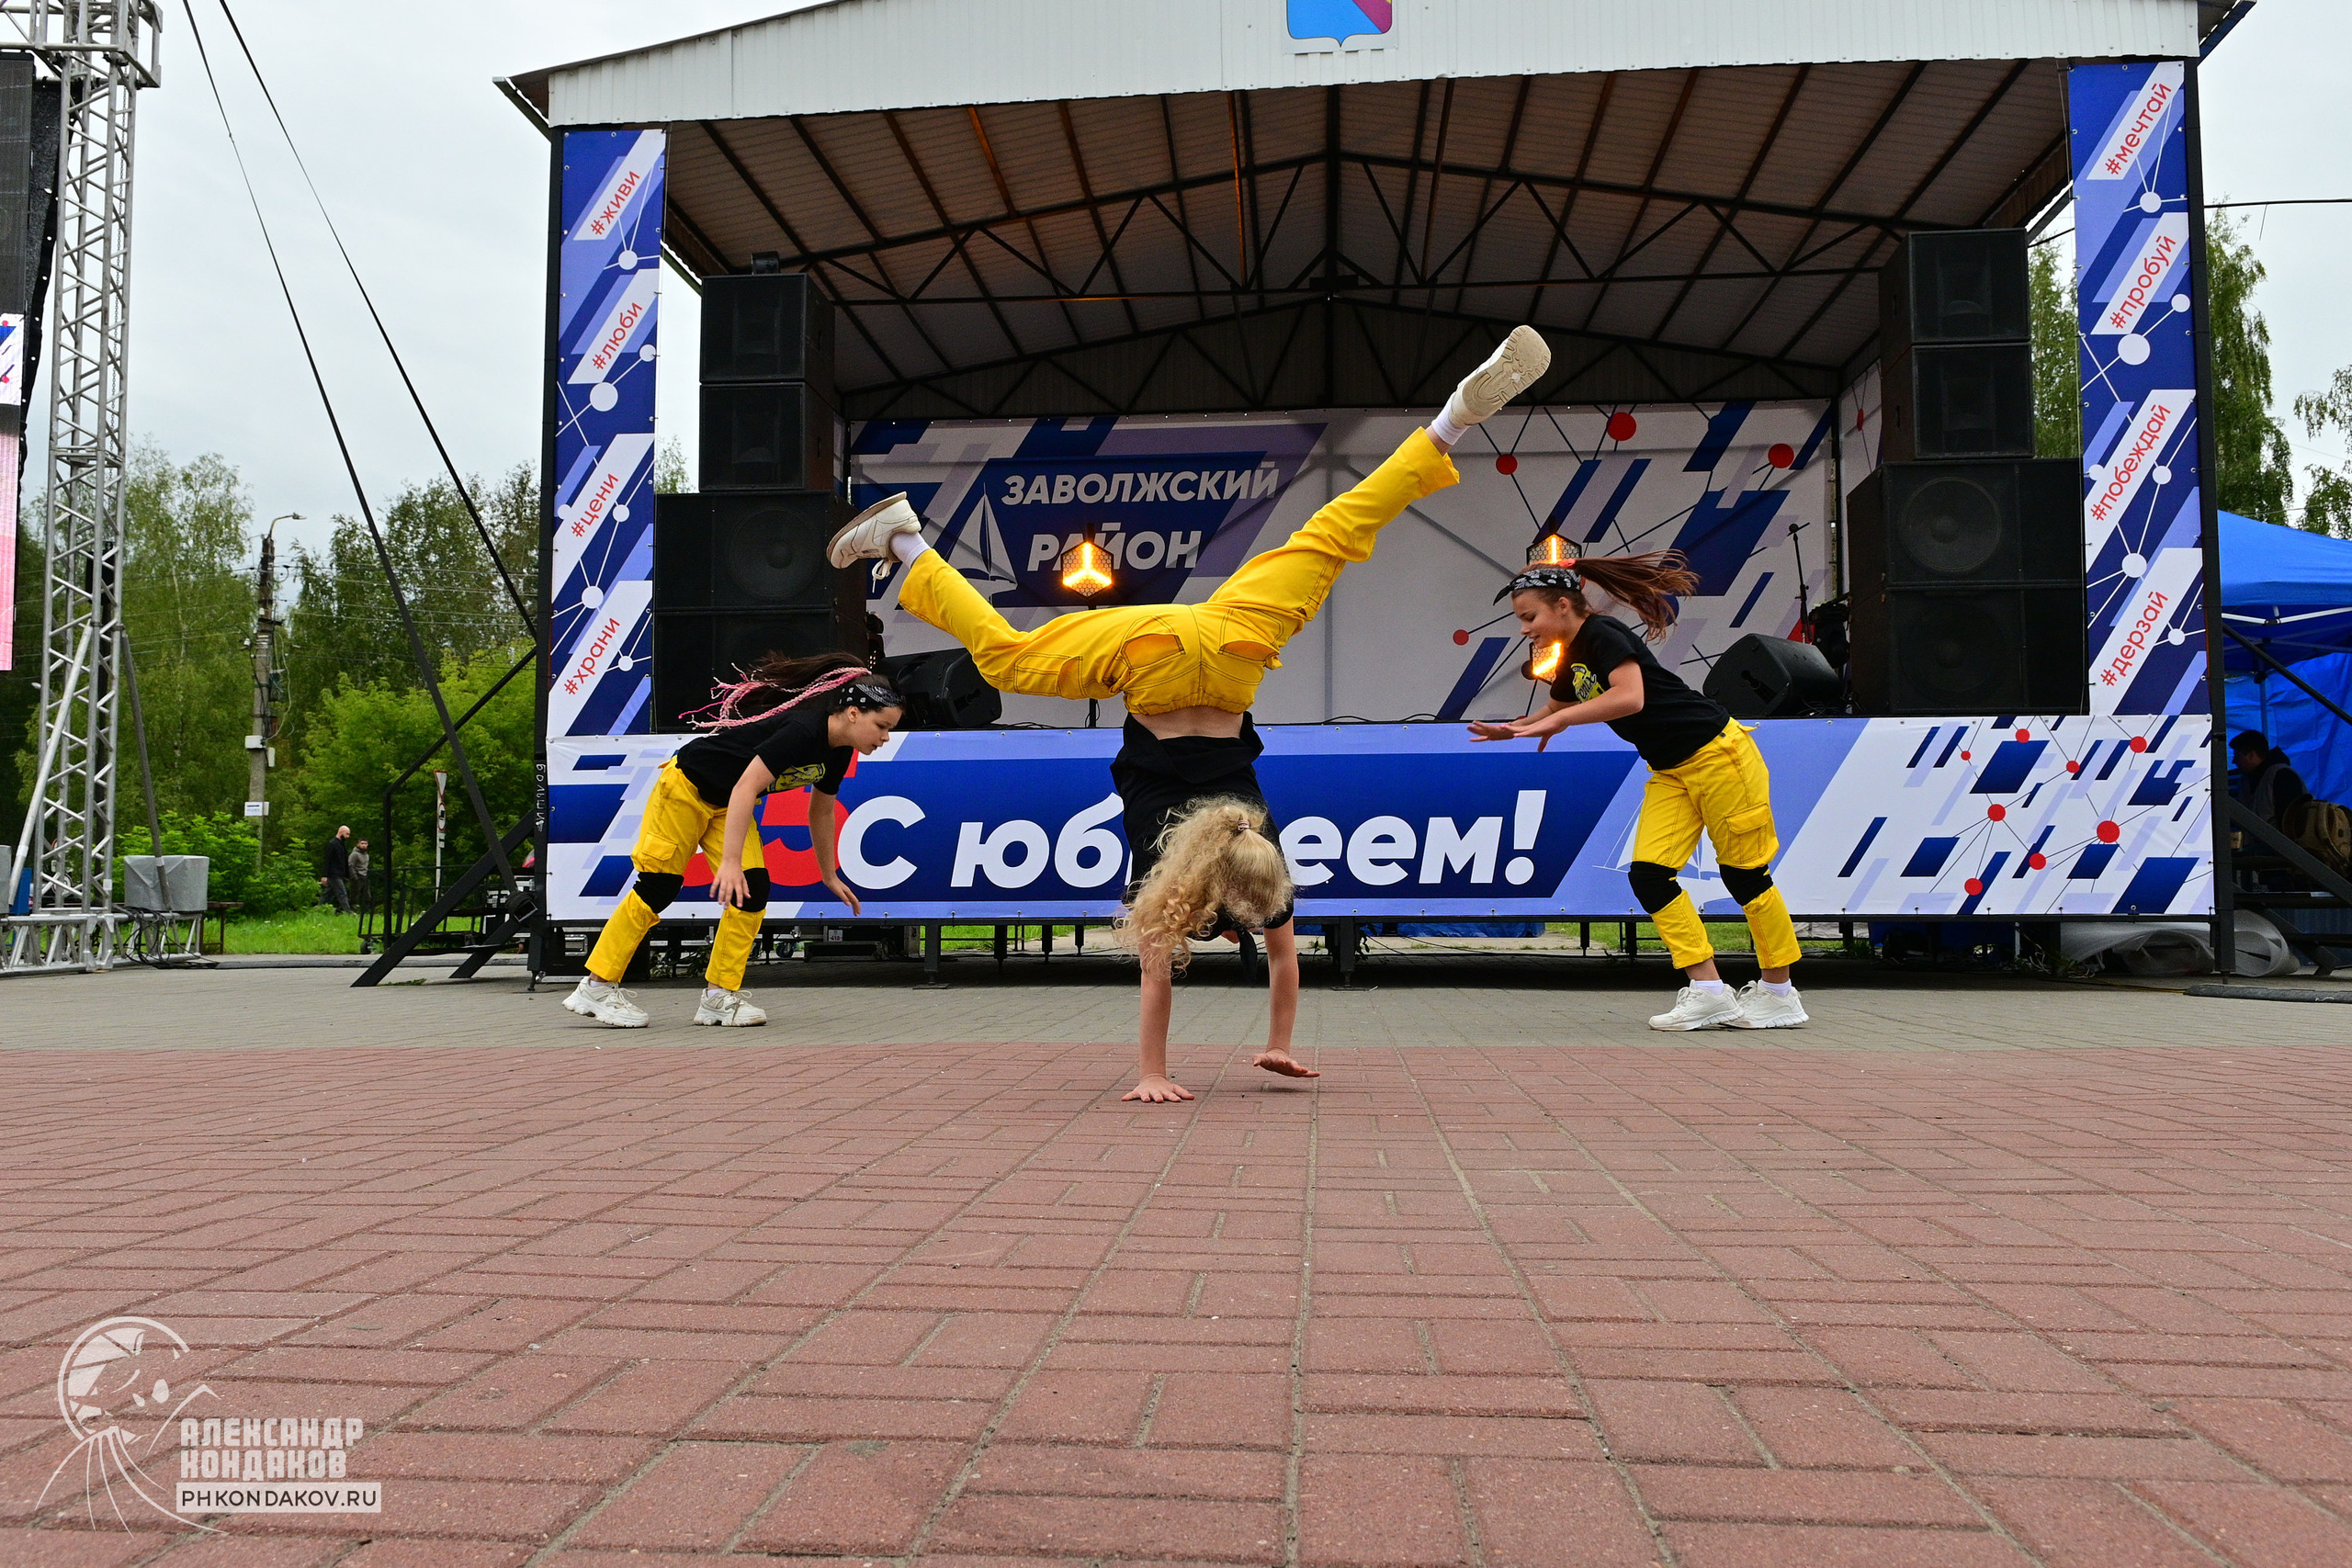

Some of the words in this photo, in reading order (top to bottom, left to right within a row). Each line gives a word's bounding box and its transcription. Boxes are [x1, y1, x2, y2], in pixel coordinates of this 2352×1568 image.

[2106, 84, 2172, 175] #мечтай
[592, 171, 640, 234] #живи
[2110, 236, 2177, 329] #пробуй
[593, 302, 643, 369] #люби
[1001, 461, 1280, 506] ЗАВОЛЖСКИЙ
[2090, 404, 2172, 521] #побеждай
[571, 473, 620, 537] #цени
[564, 617, 621, 695] #храни
[2100, 592, 2169, 686] #дерзай
[837, 795, 926, 889] С
[950, 790, 1547, 889] юбеем!
